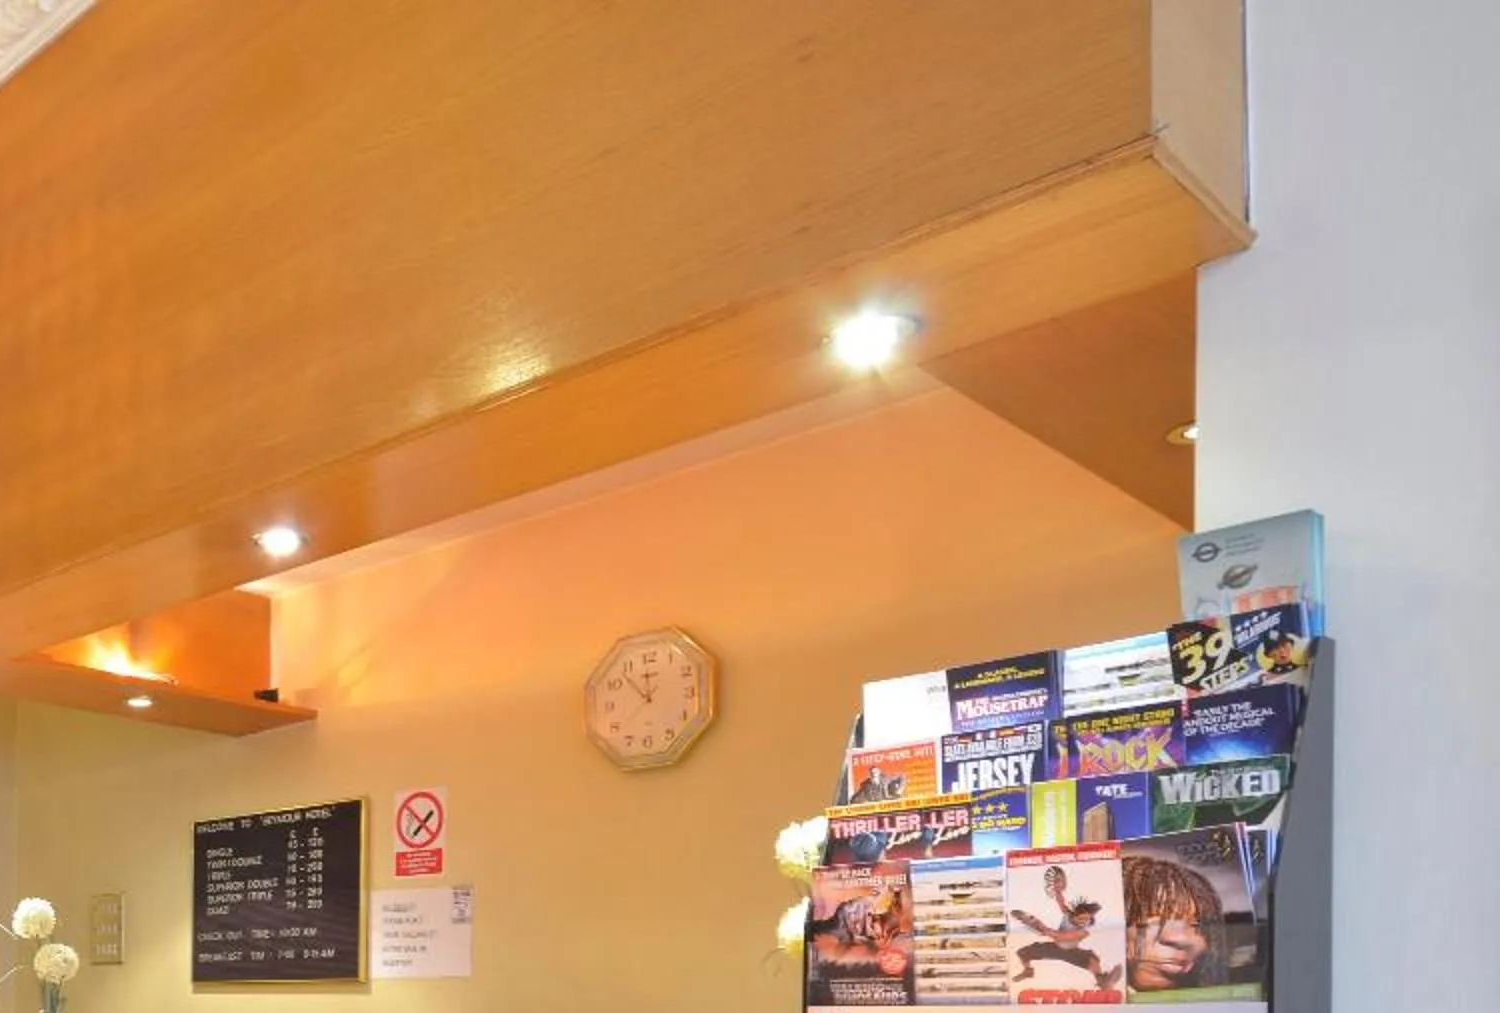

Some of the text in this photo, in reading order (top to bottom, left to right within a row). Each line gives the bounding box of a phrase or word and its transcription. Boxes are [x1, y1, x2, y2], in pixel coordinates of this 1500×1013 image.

[1180, 631, 1232, 685] 39
[1201, 655, 1250, 693] STEPS
[956, 694, 1048, 720] MOUSETRAP
[1076, 727, 1178, 776] ROCK
[952, 752, 1035, 793] JERSEY
[1157, 769, 1280, 805] WICKED
[831, 813, 921, 839] THRILLER
